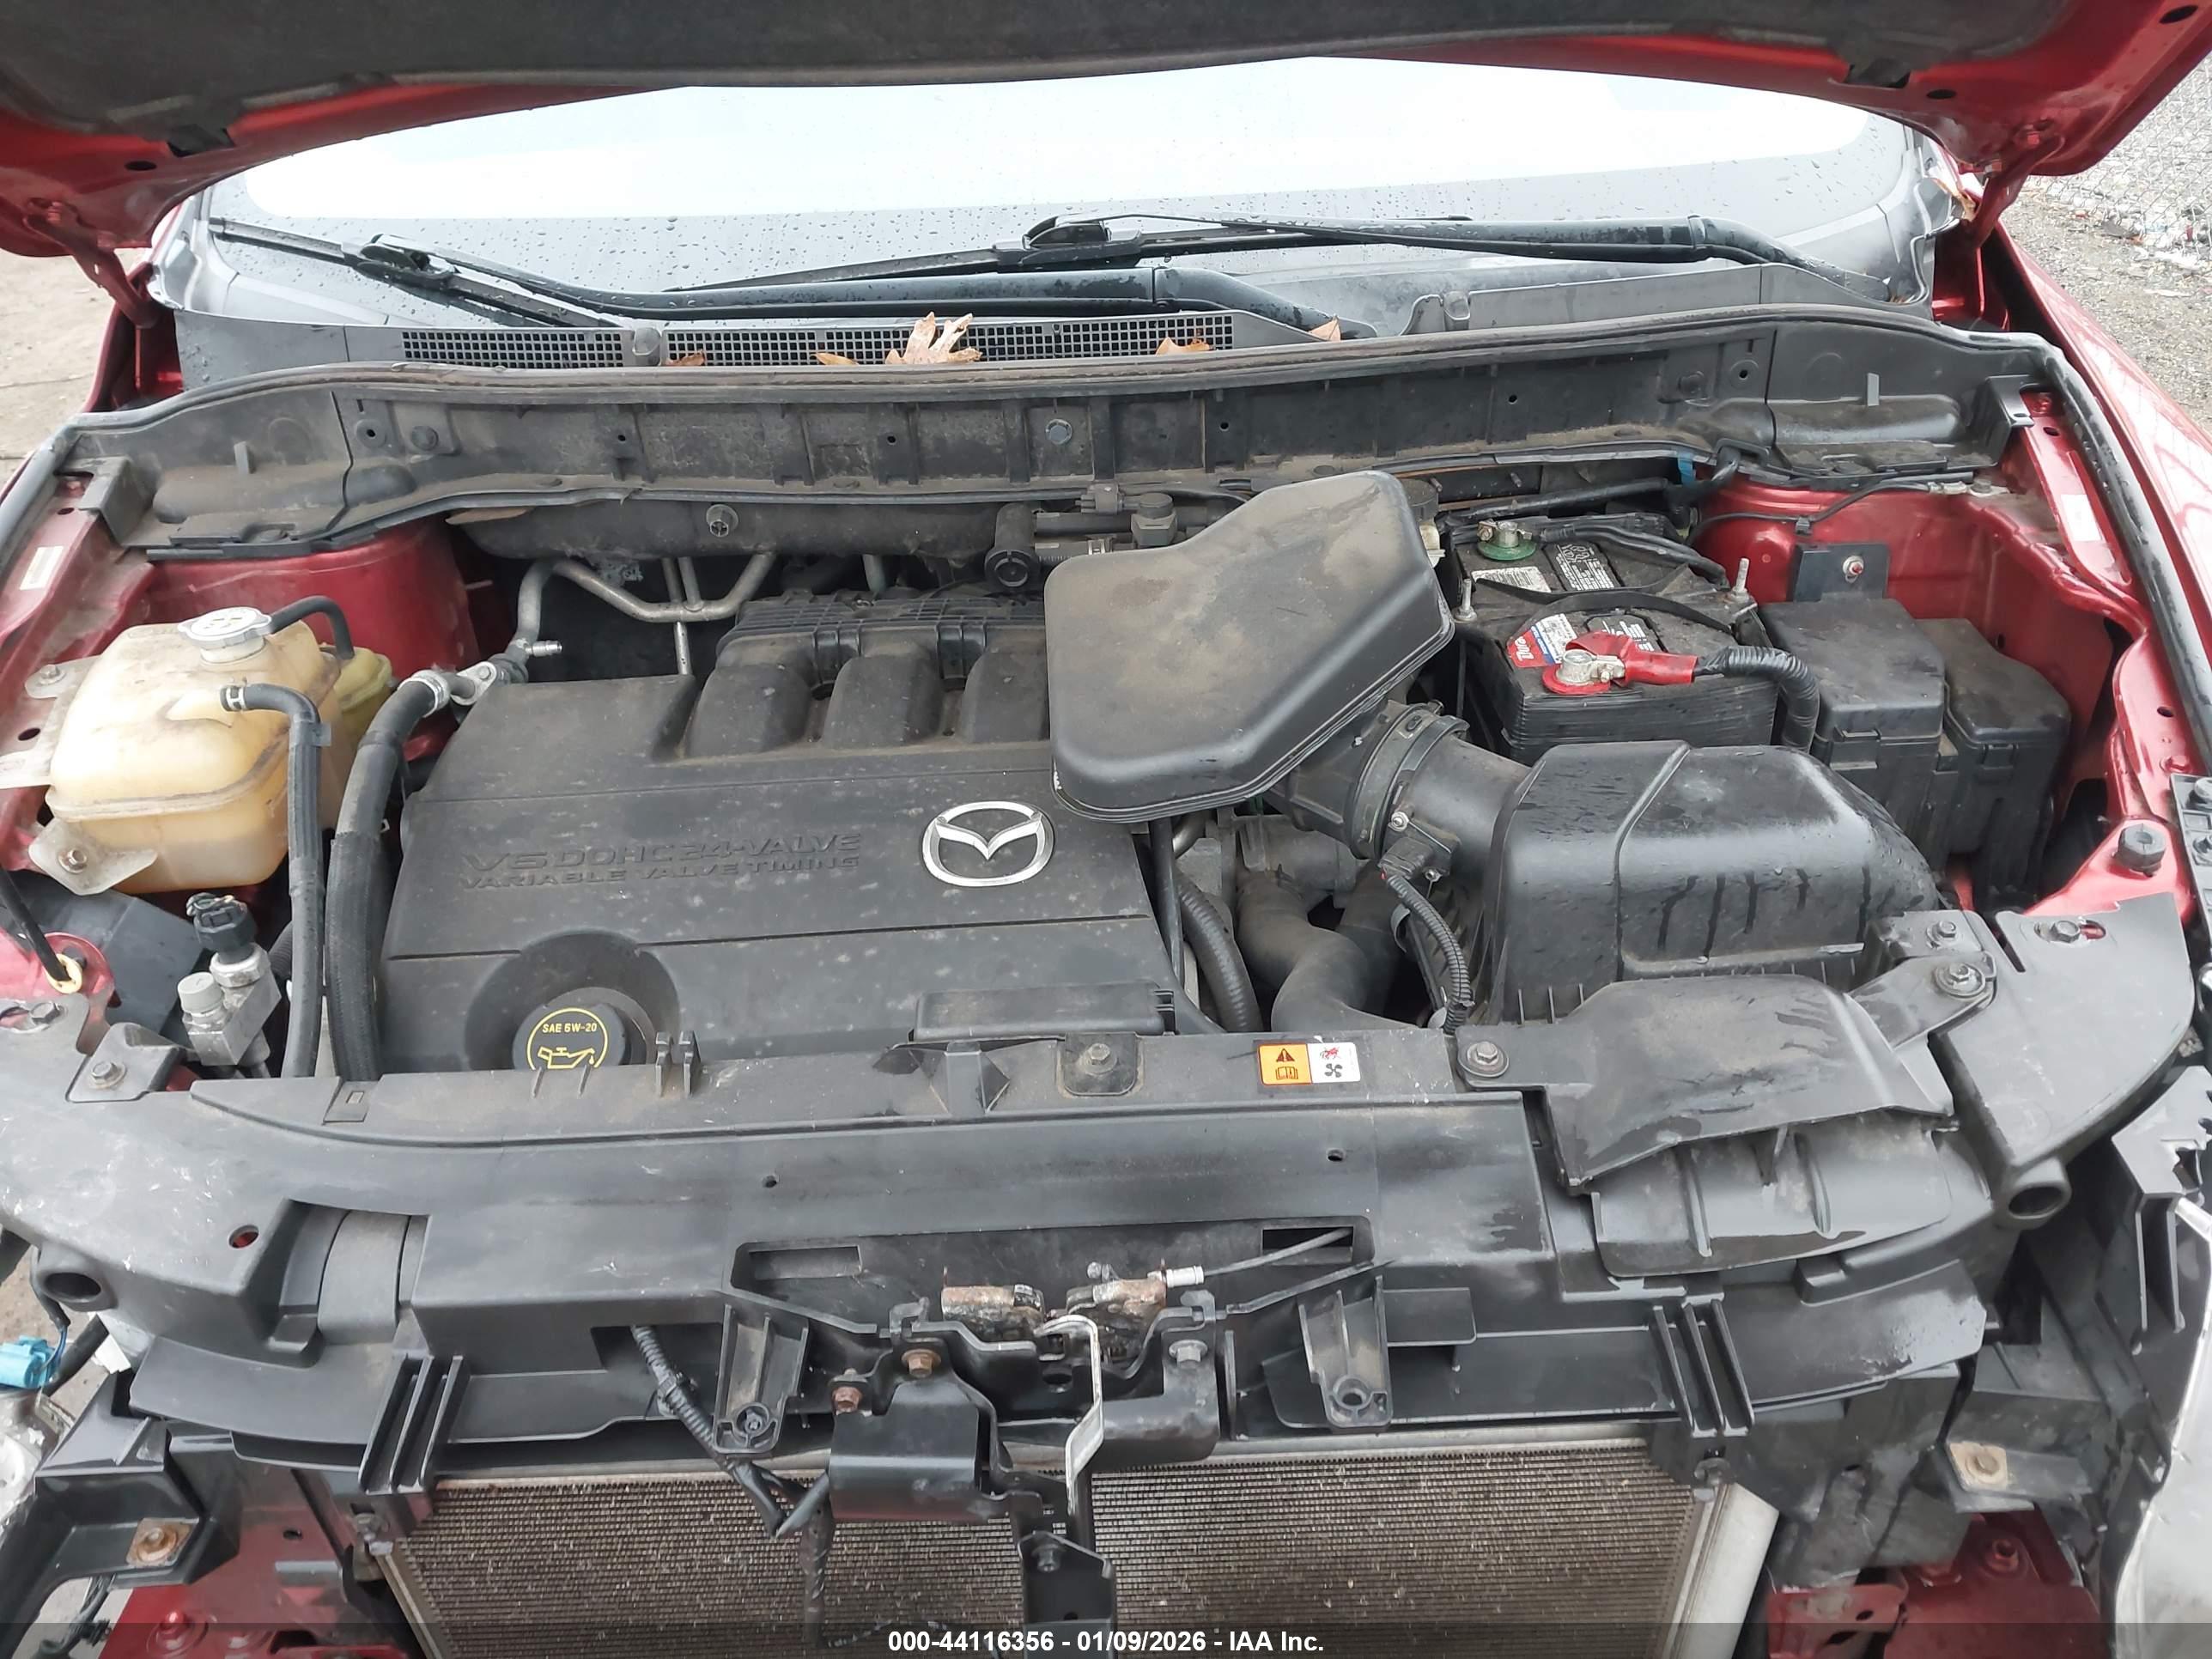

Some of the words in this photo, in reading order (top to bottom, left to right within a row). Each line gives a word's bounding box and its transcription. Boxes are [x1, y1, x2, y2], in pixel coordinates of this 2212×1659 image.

[459, 869, 627, 890] VARIABLE
[641, 862, 739, 881] VALVE
[746, 856, 860, 874] TIMING
[542, 1023, 562, 1033] SAE
[564, 1023, 598, 1033] 5W-20
